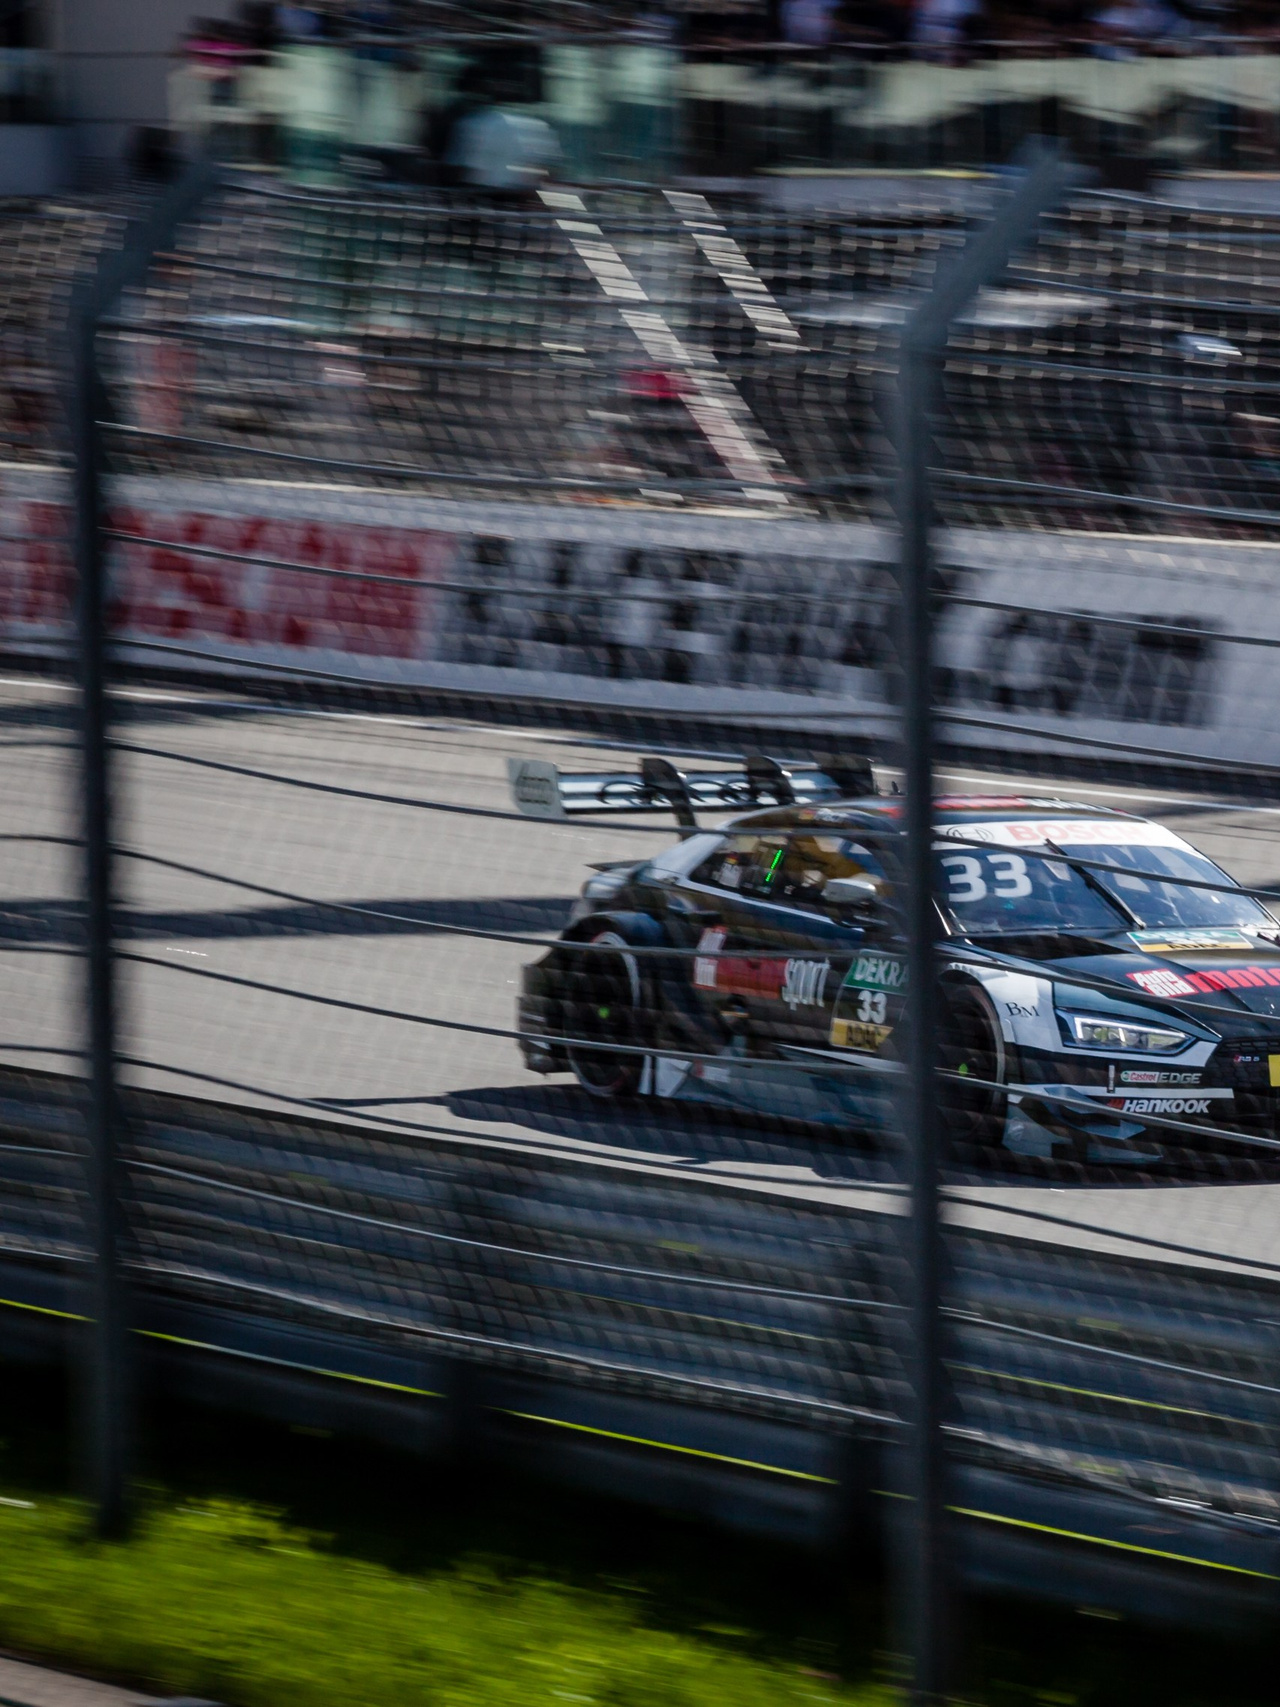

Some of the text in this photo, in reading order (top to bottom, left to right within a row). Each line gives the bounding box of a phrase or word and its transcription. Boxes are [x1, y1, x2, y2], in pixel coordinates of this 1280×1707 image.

[1005, 824, 1149, 841] BOSCH
[940, 854, 1033, 902] 33
[857, 990, 887, 1024] 33
[1130, 1072, 1202, 1084] Castrol EDGE
